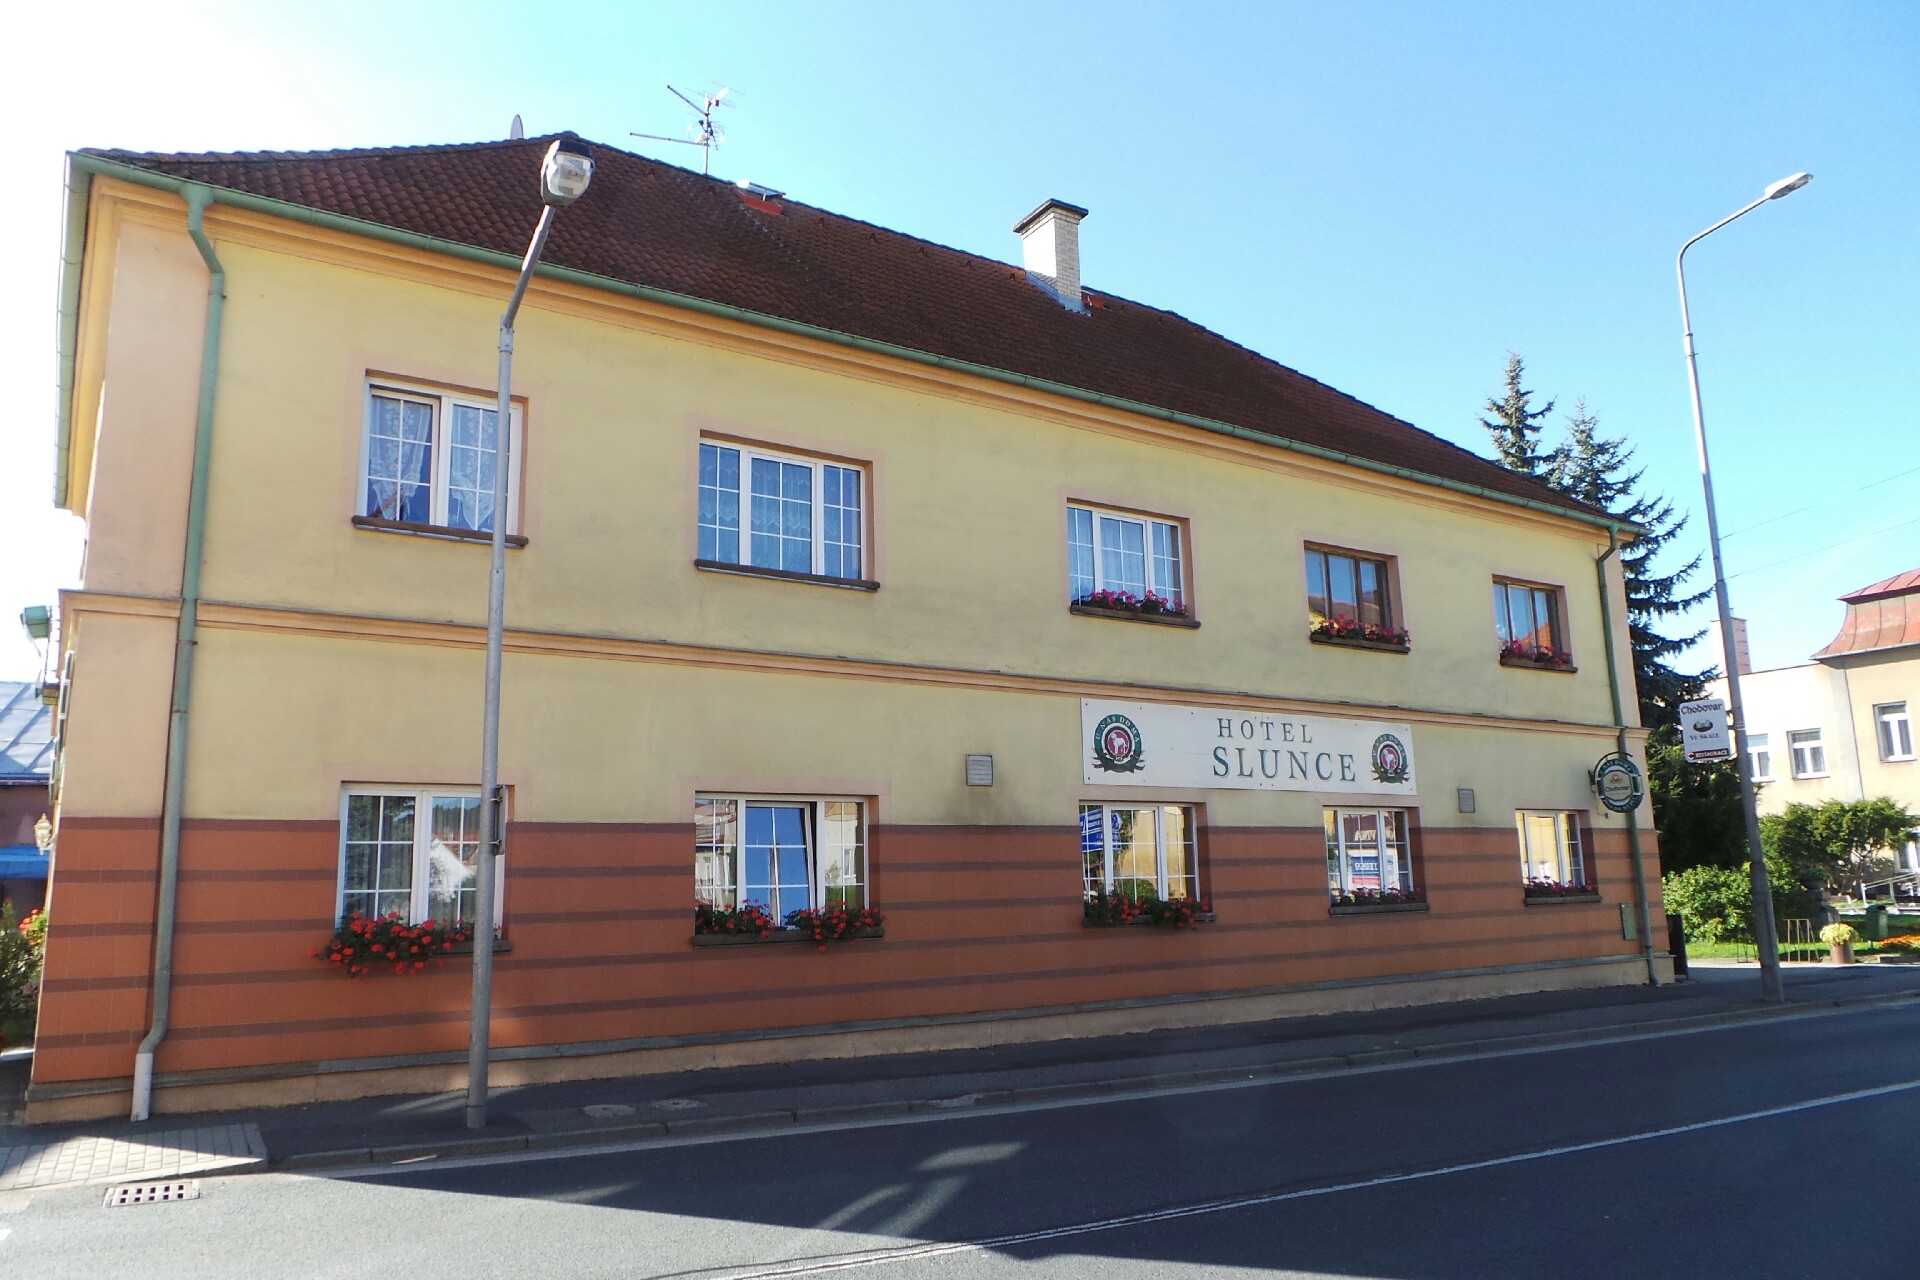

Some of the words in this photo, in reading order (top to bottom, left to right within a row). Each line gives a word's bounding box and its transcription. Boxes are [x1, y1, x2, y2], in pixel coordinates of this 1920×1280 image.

[1681, 703, 1722, 715] Chodovar
[1217, 717, 1313, 743] HOTEL
[1213, 746, 1357, 782] SLUNCE
